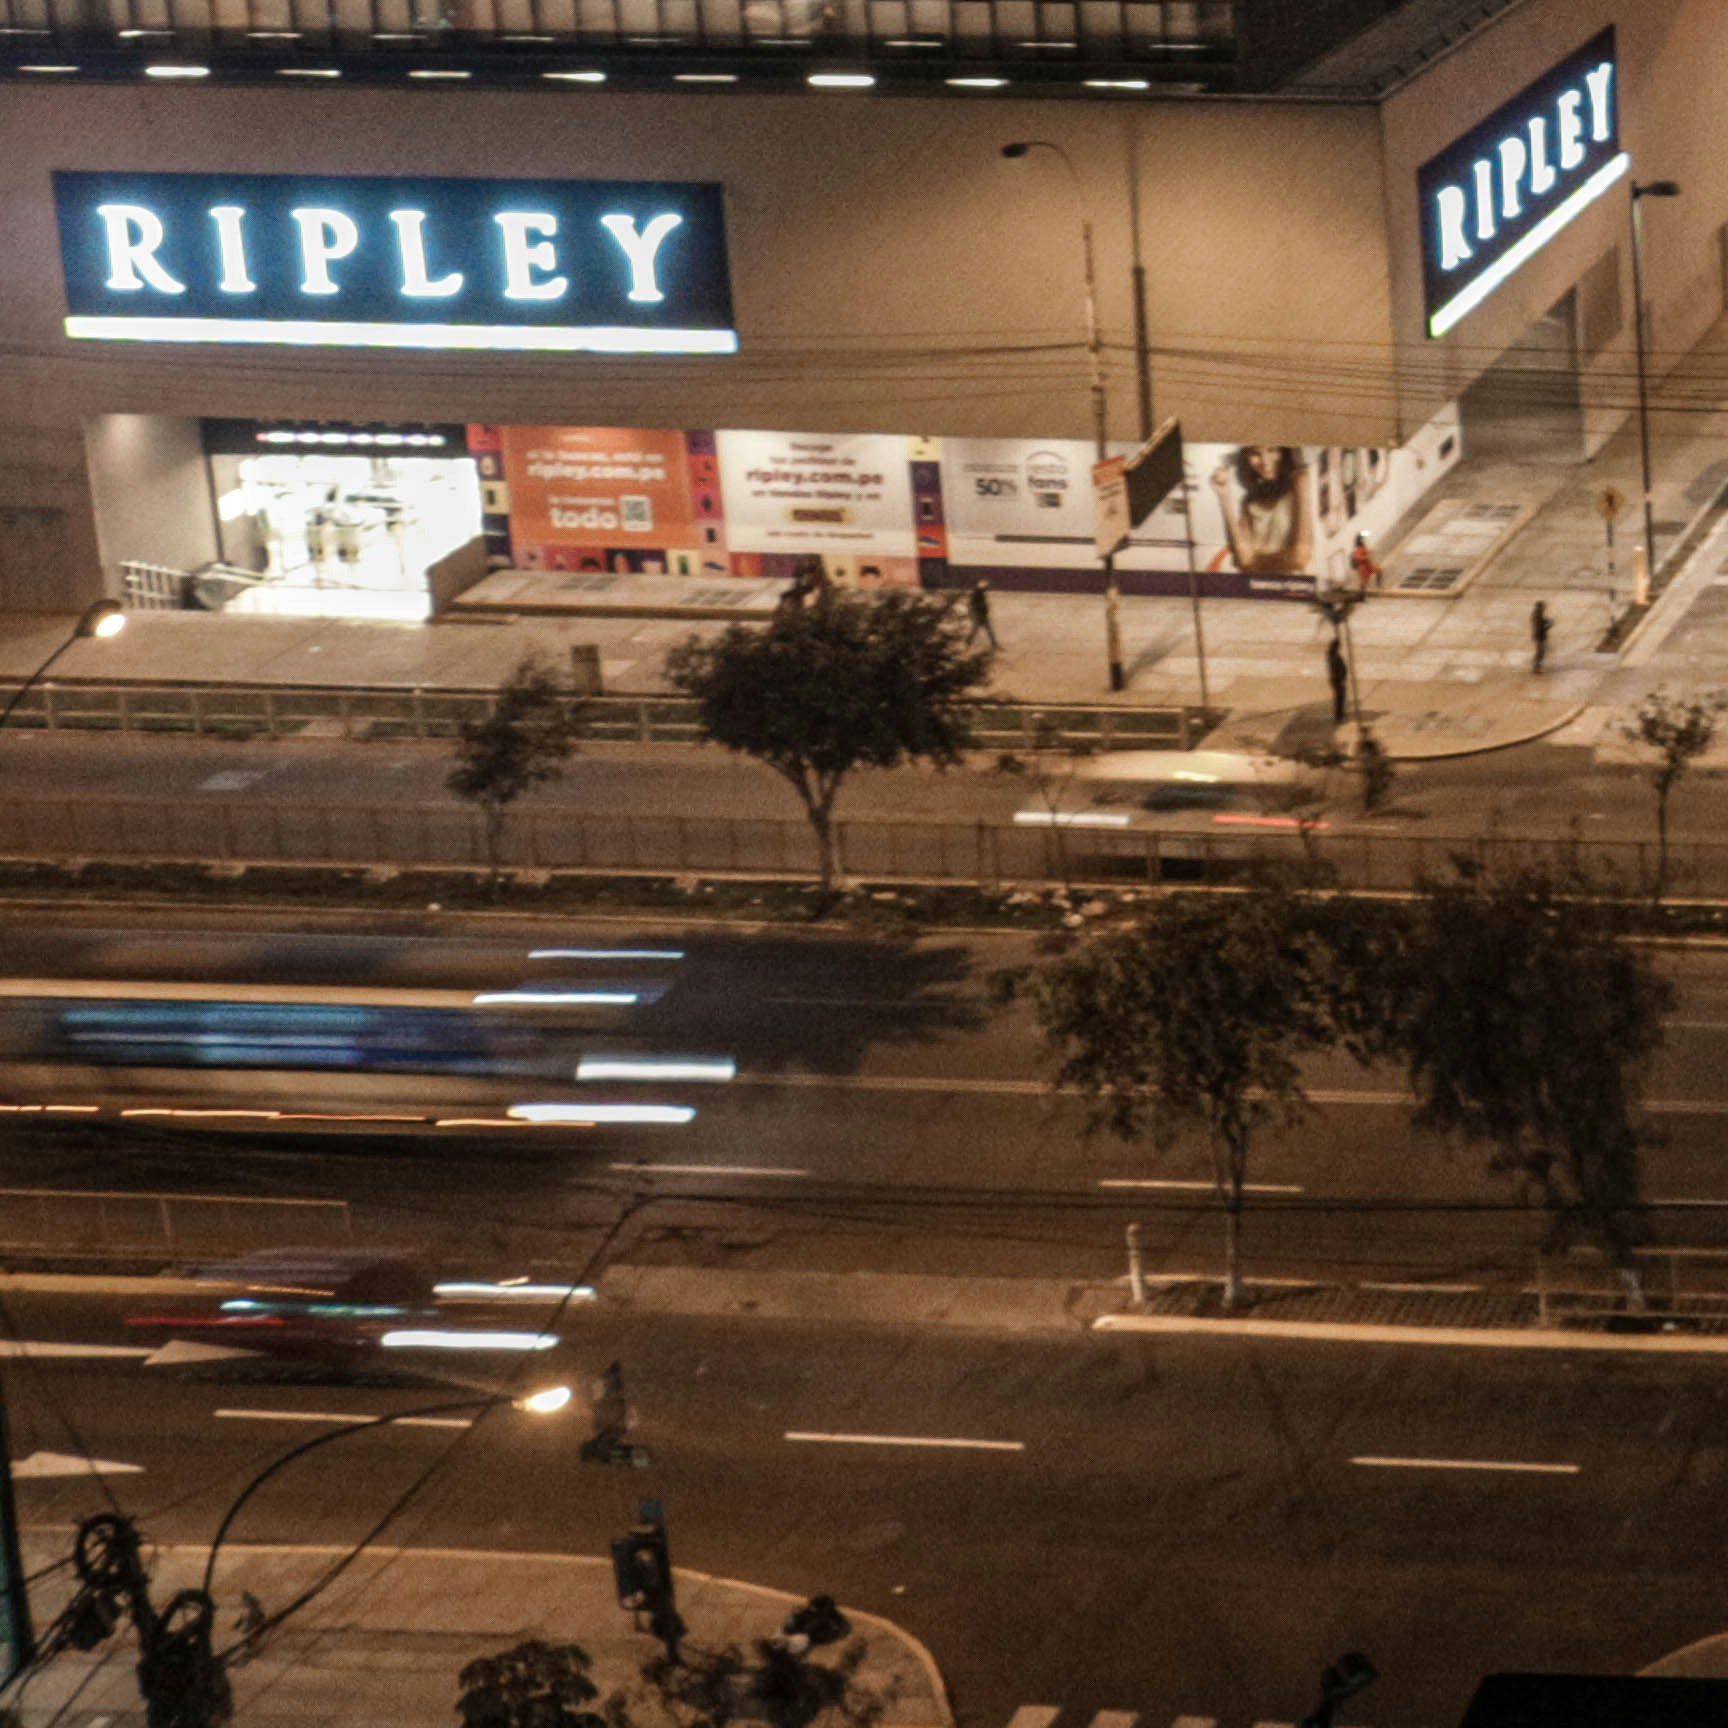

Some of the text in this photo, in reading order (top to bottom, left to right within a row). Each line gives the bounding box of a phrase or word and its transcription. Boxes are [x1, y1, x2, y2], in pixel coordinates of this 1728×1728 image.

[1435, 61, 1614, 272] RIPLEY
[97, 203, 685, 303] RIPLEY
[746, 467, 884, 487] ripley.com.pe
[549, 506, 618, 530] todo
